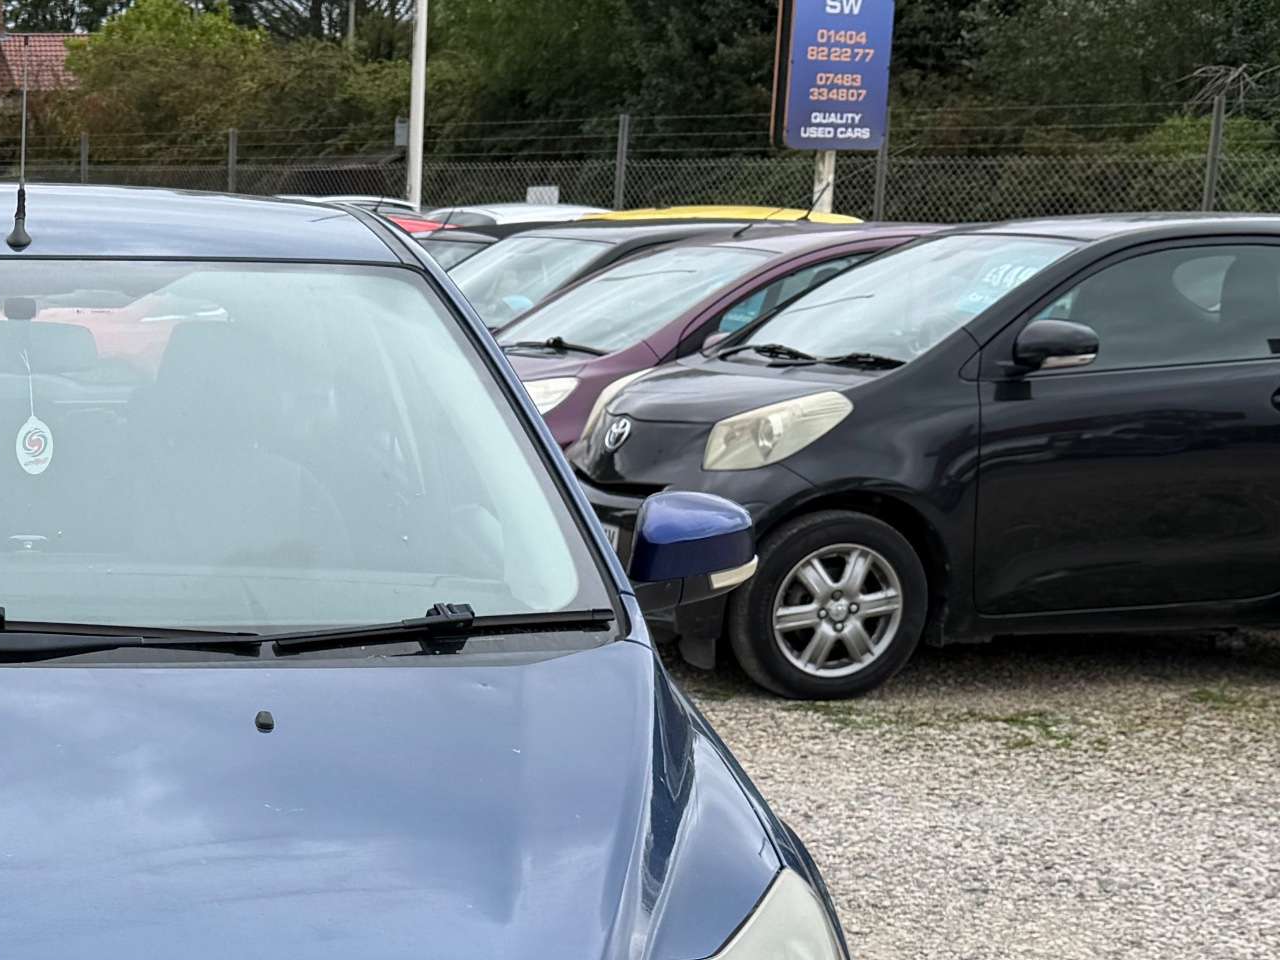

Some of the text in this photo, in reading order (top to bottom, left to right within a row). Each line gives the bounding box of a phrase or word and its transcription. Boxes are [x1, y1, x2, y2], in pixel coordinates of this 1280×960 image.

[825, 0, 862, 14] SW
[817, 29, 867, 44] 01404
[816, 73, 861, 86] 07483
[809, 88, 866, 101] 334807
[811, 112, 862, 124] QUALITY
[801, 126, 870, 139] USED CARS
